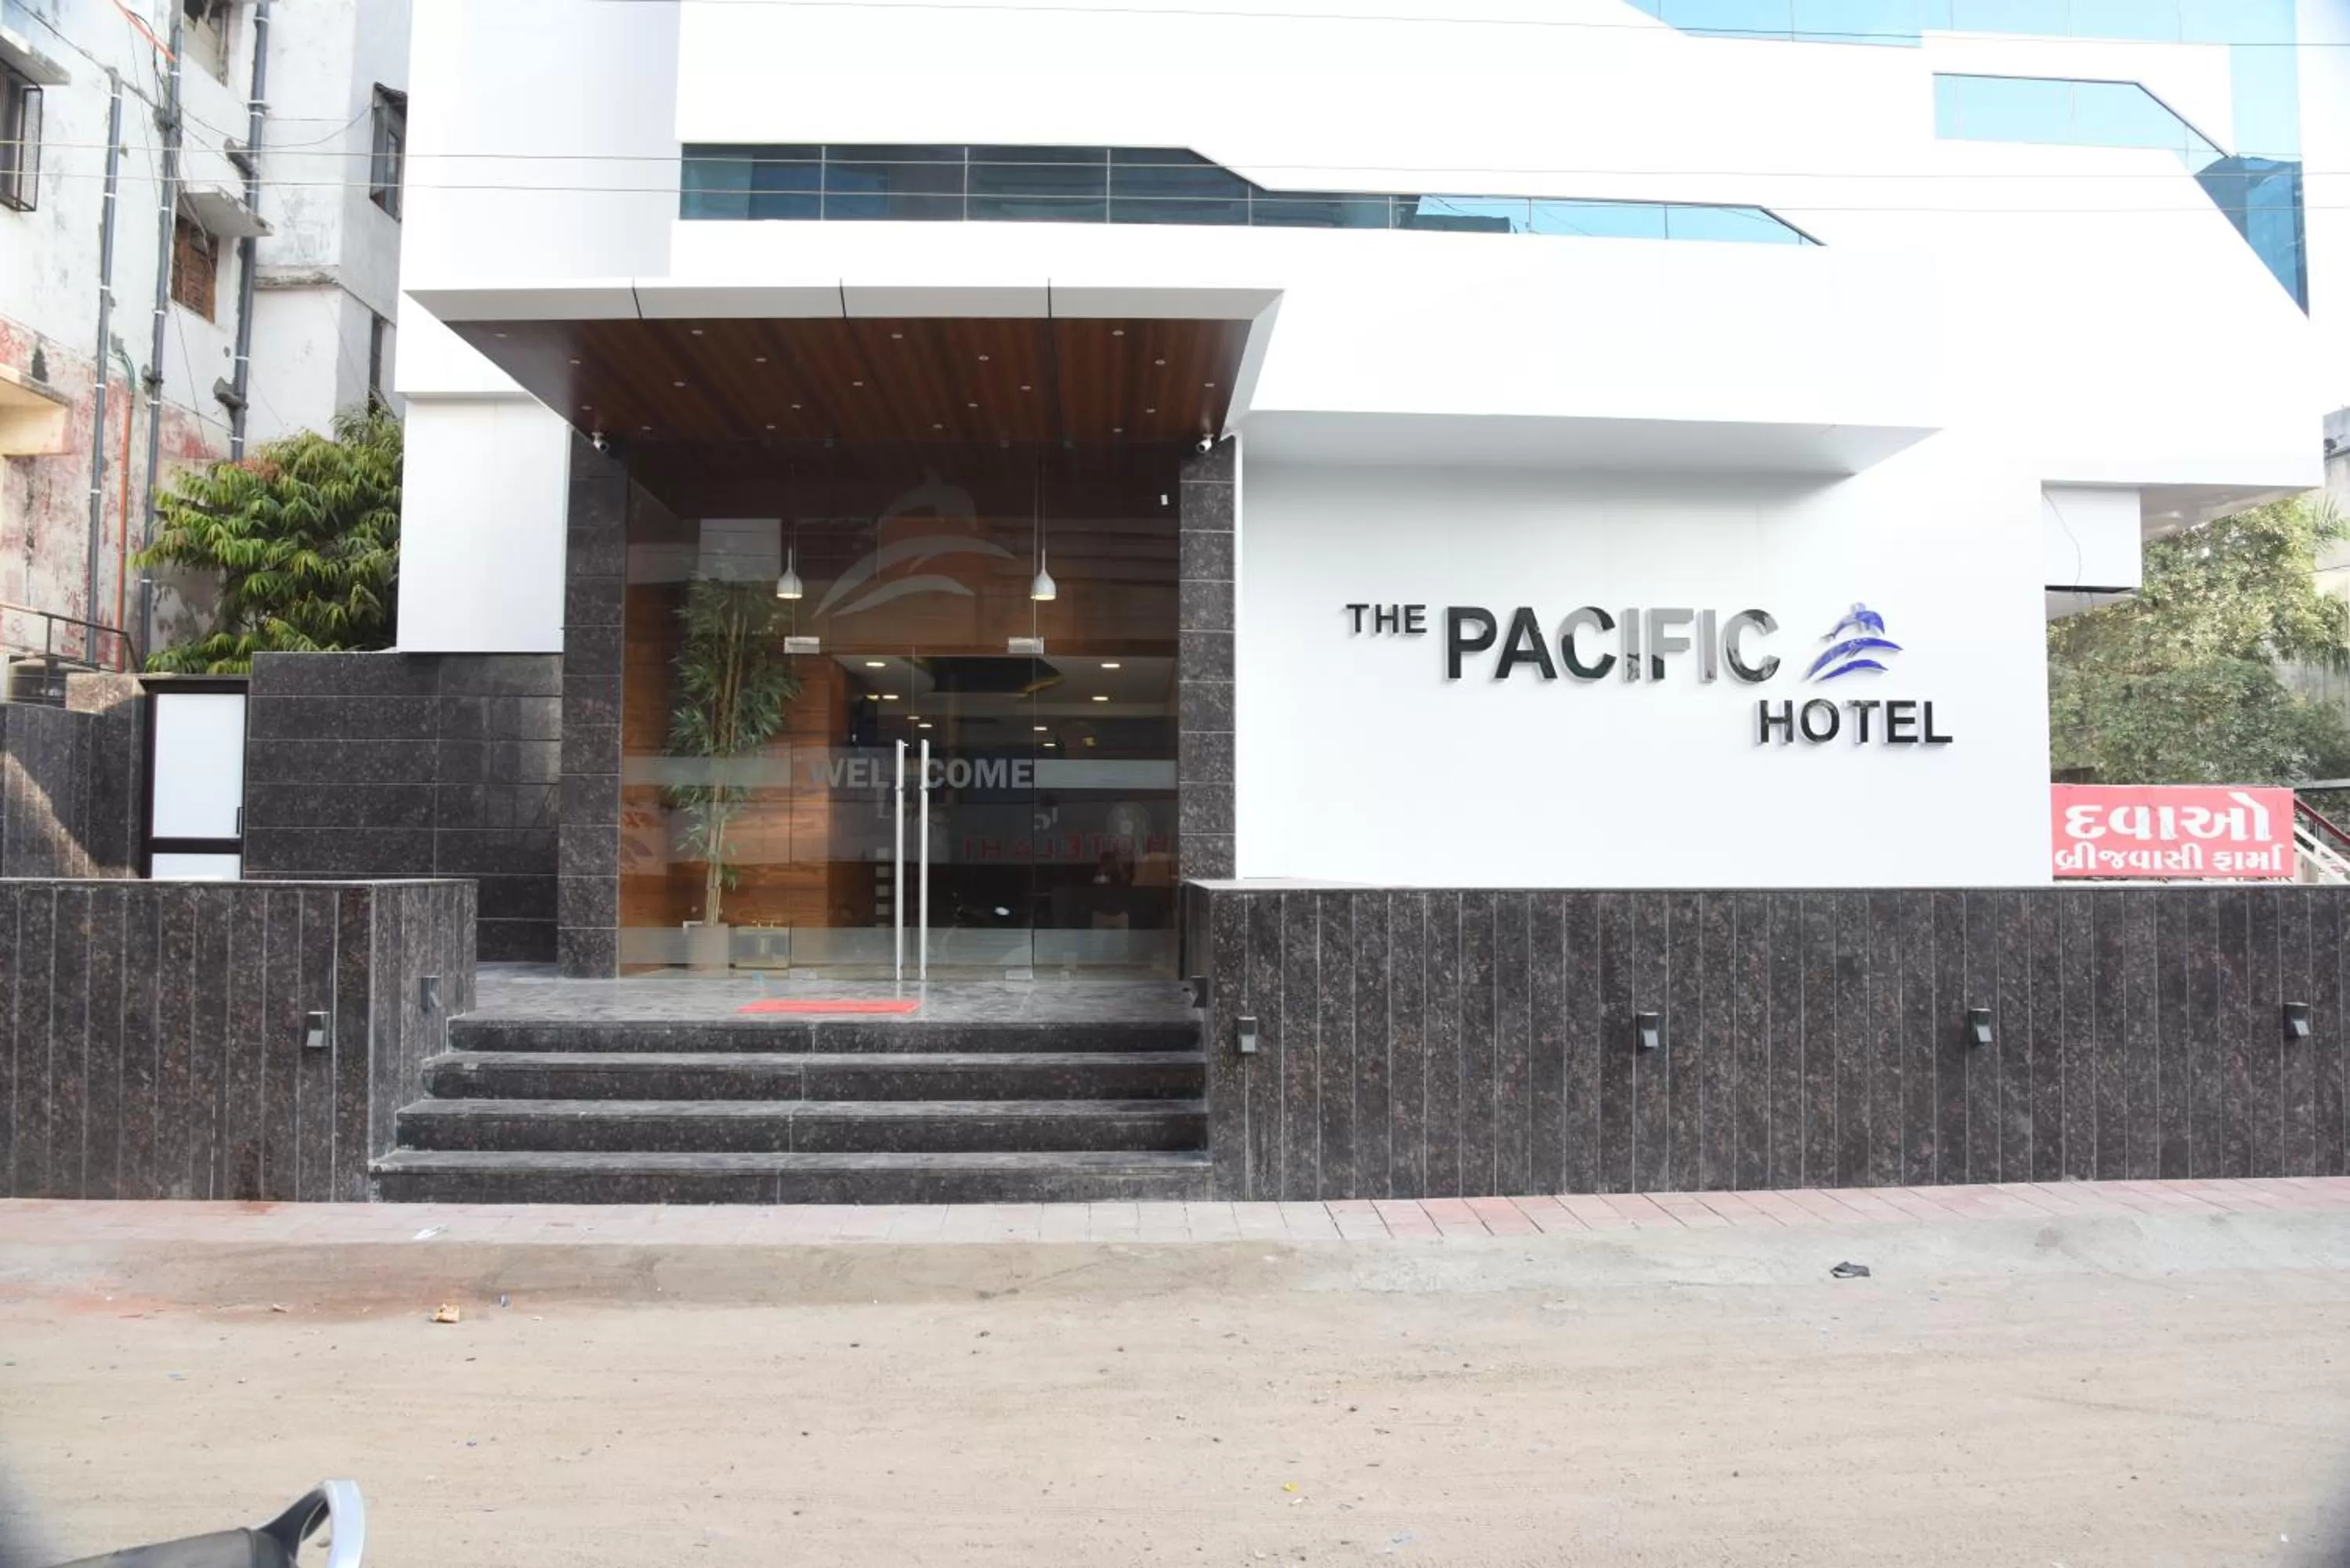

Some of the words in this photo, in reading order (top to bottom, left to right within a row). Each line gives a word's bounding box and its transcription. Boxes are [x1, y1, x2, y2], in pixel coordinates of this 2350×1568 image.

[1346, 603, 1427, 634] THE
[1444, 605, 1781, 681] PACIFIC
[1758, 698, 1954, 744] HOTEL
[2064, 791, 2272, 841] દવાઓ
